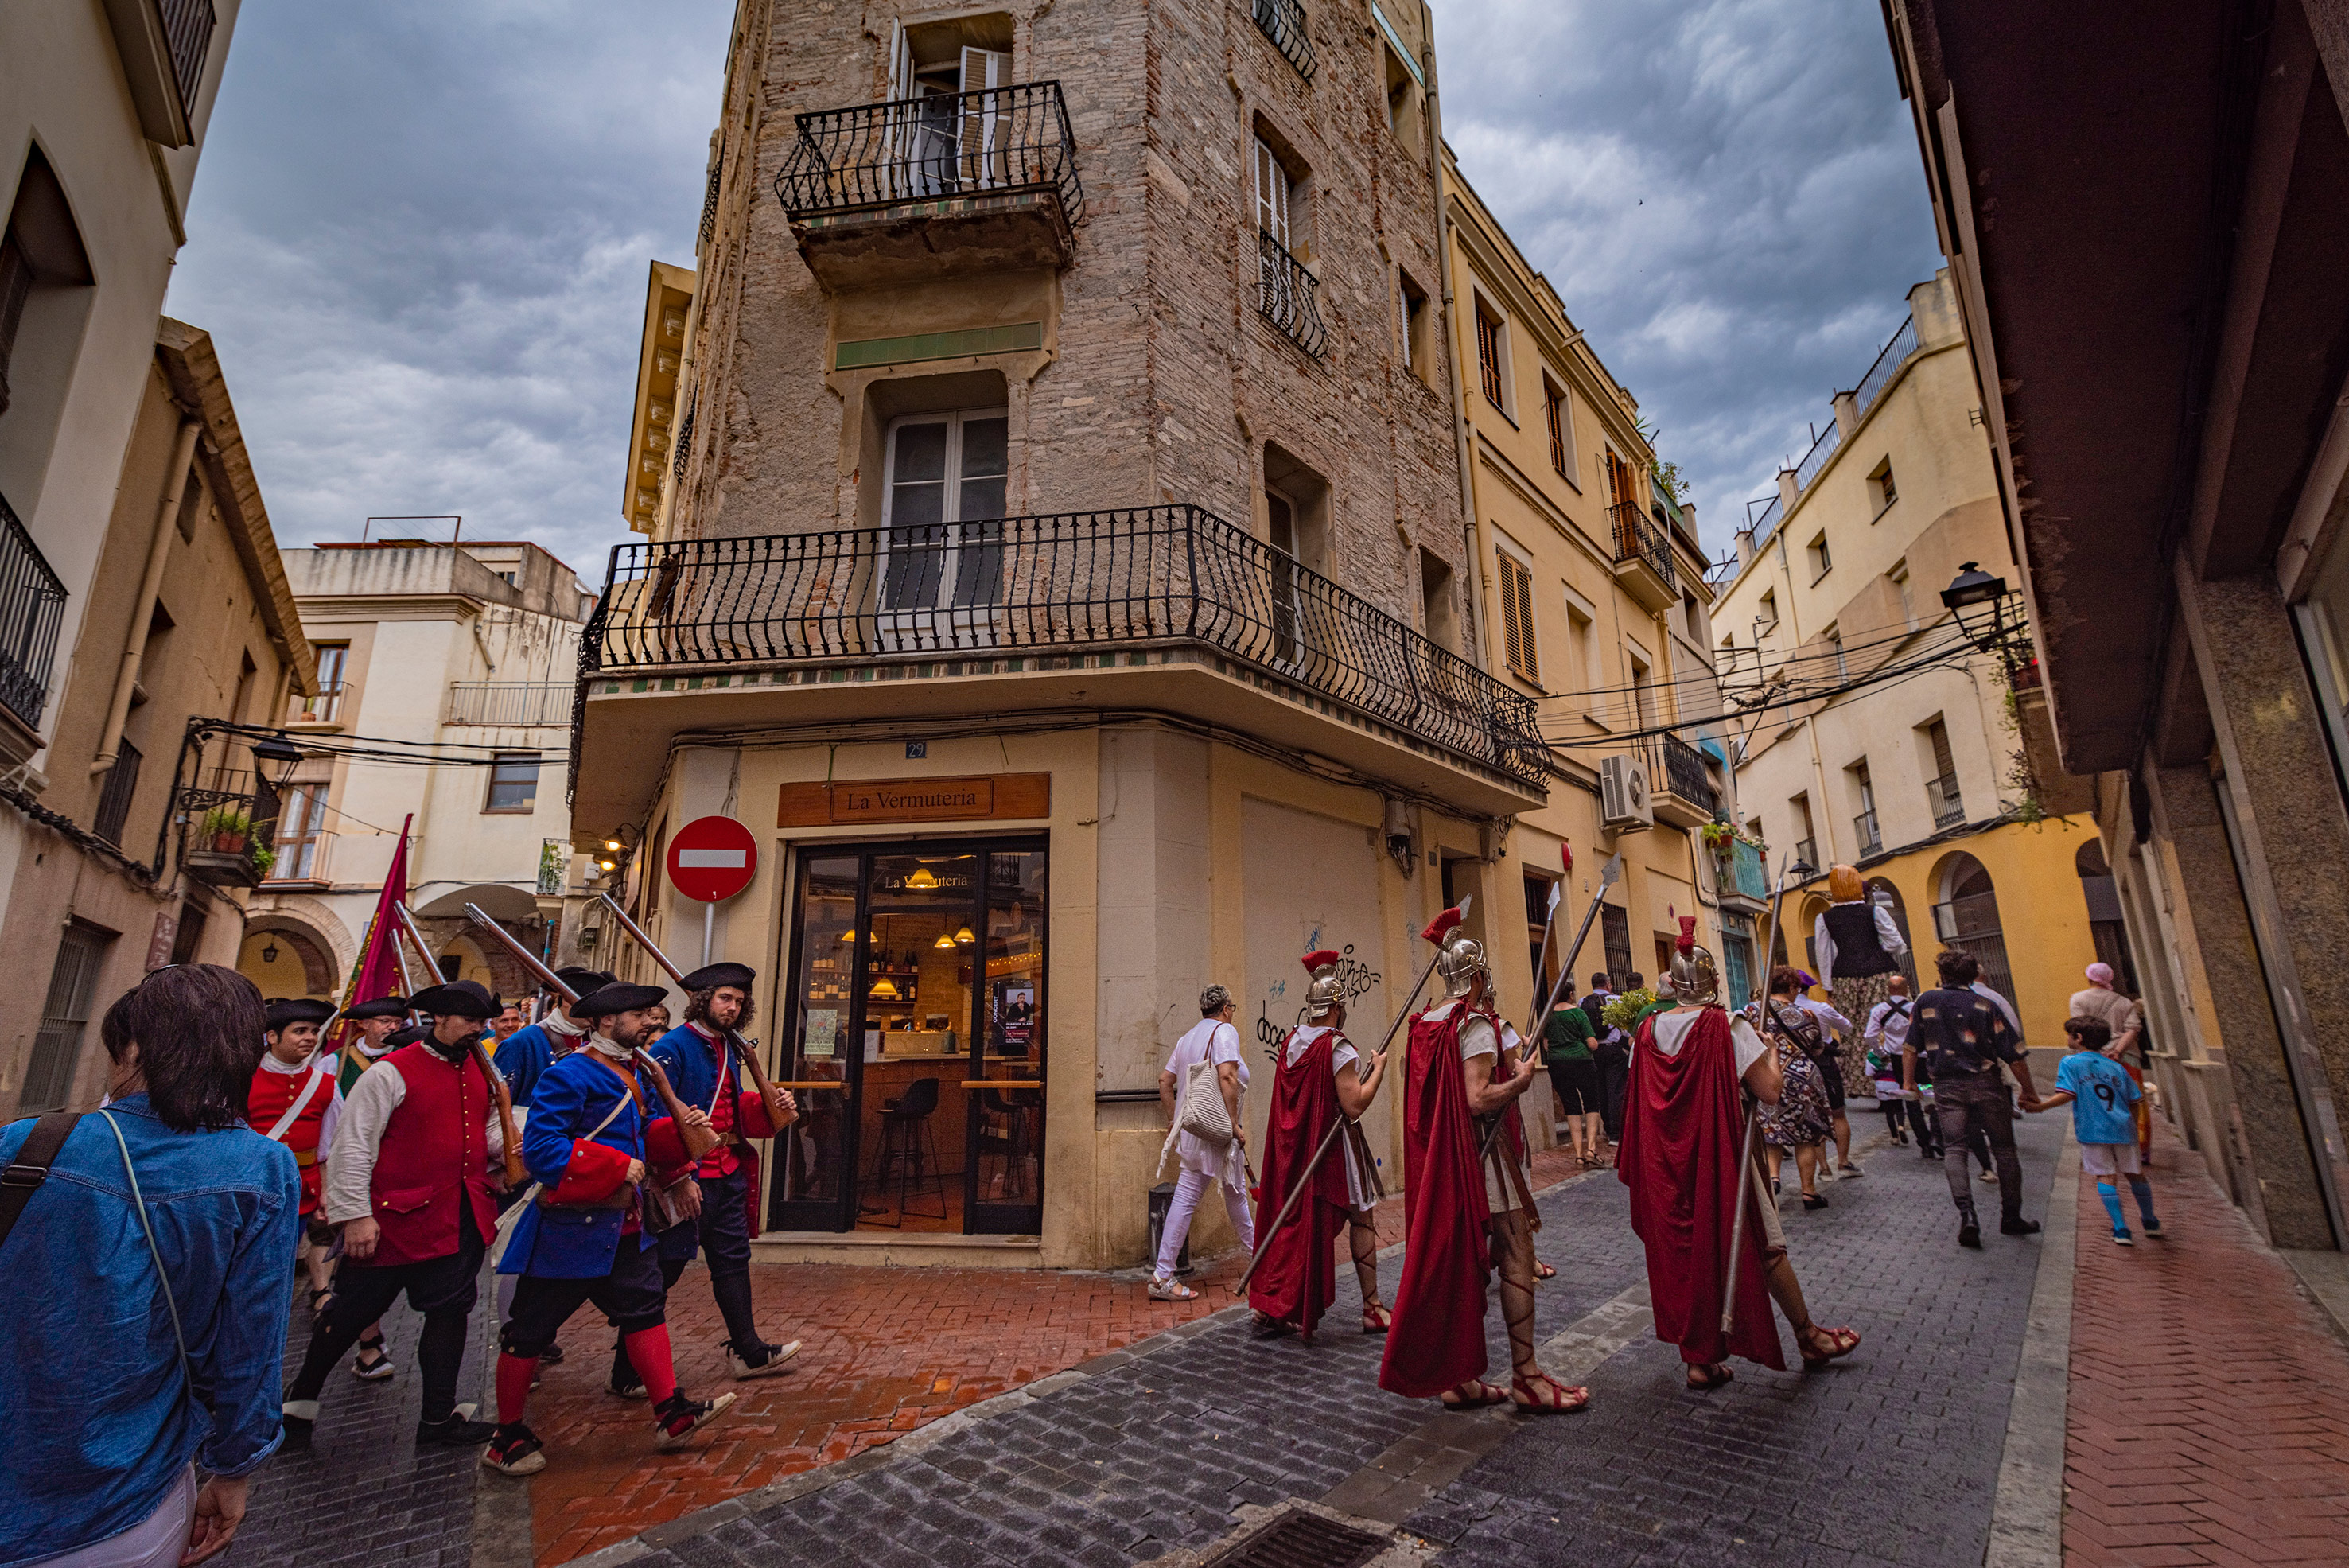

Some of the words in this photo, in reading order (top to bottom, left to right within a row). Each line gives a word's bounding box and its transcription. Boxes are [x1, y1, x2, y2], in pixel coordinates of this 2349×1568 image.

[908, 743, 924, 757] 29
[847, 793, 869, 811] La
[877, 788, 977, 809] Vermuteria
[885, 877, 900, 889] La
[2094, 1084, 2114, 1111] 9
